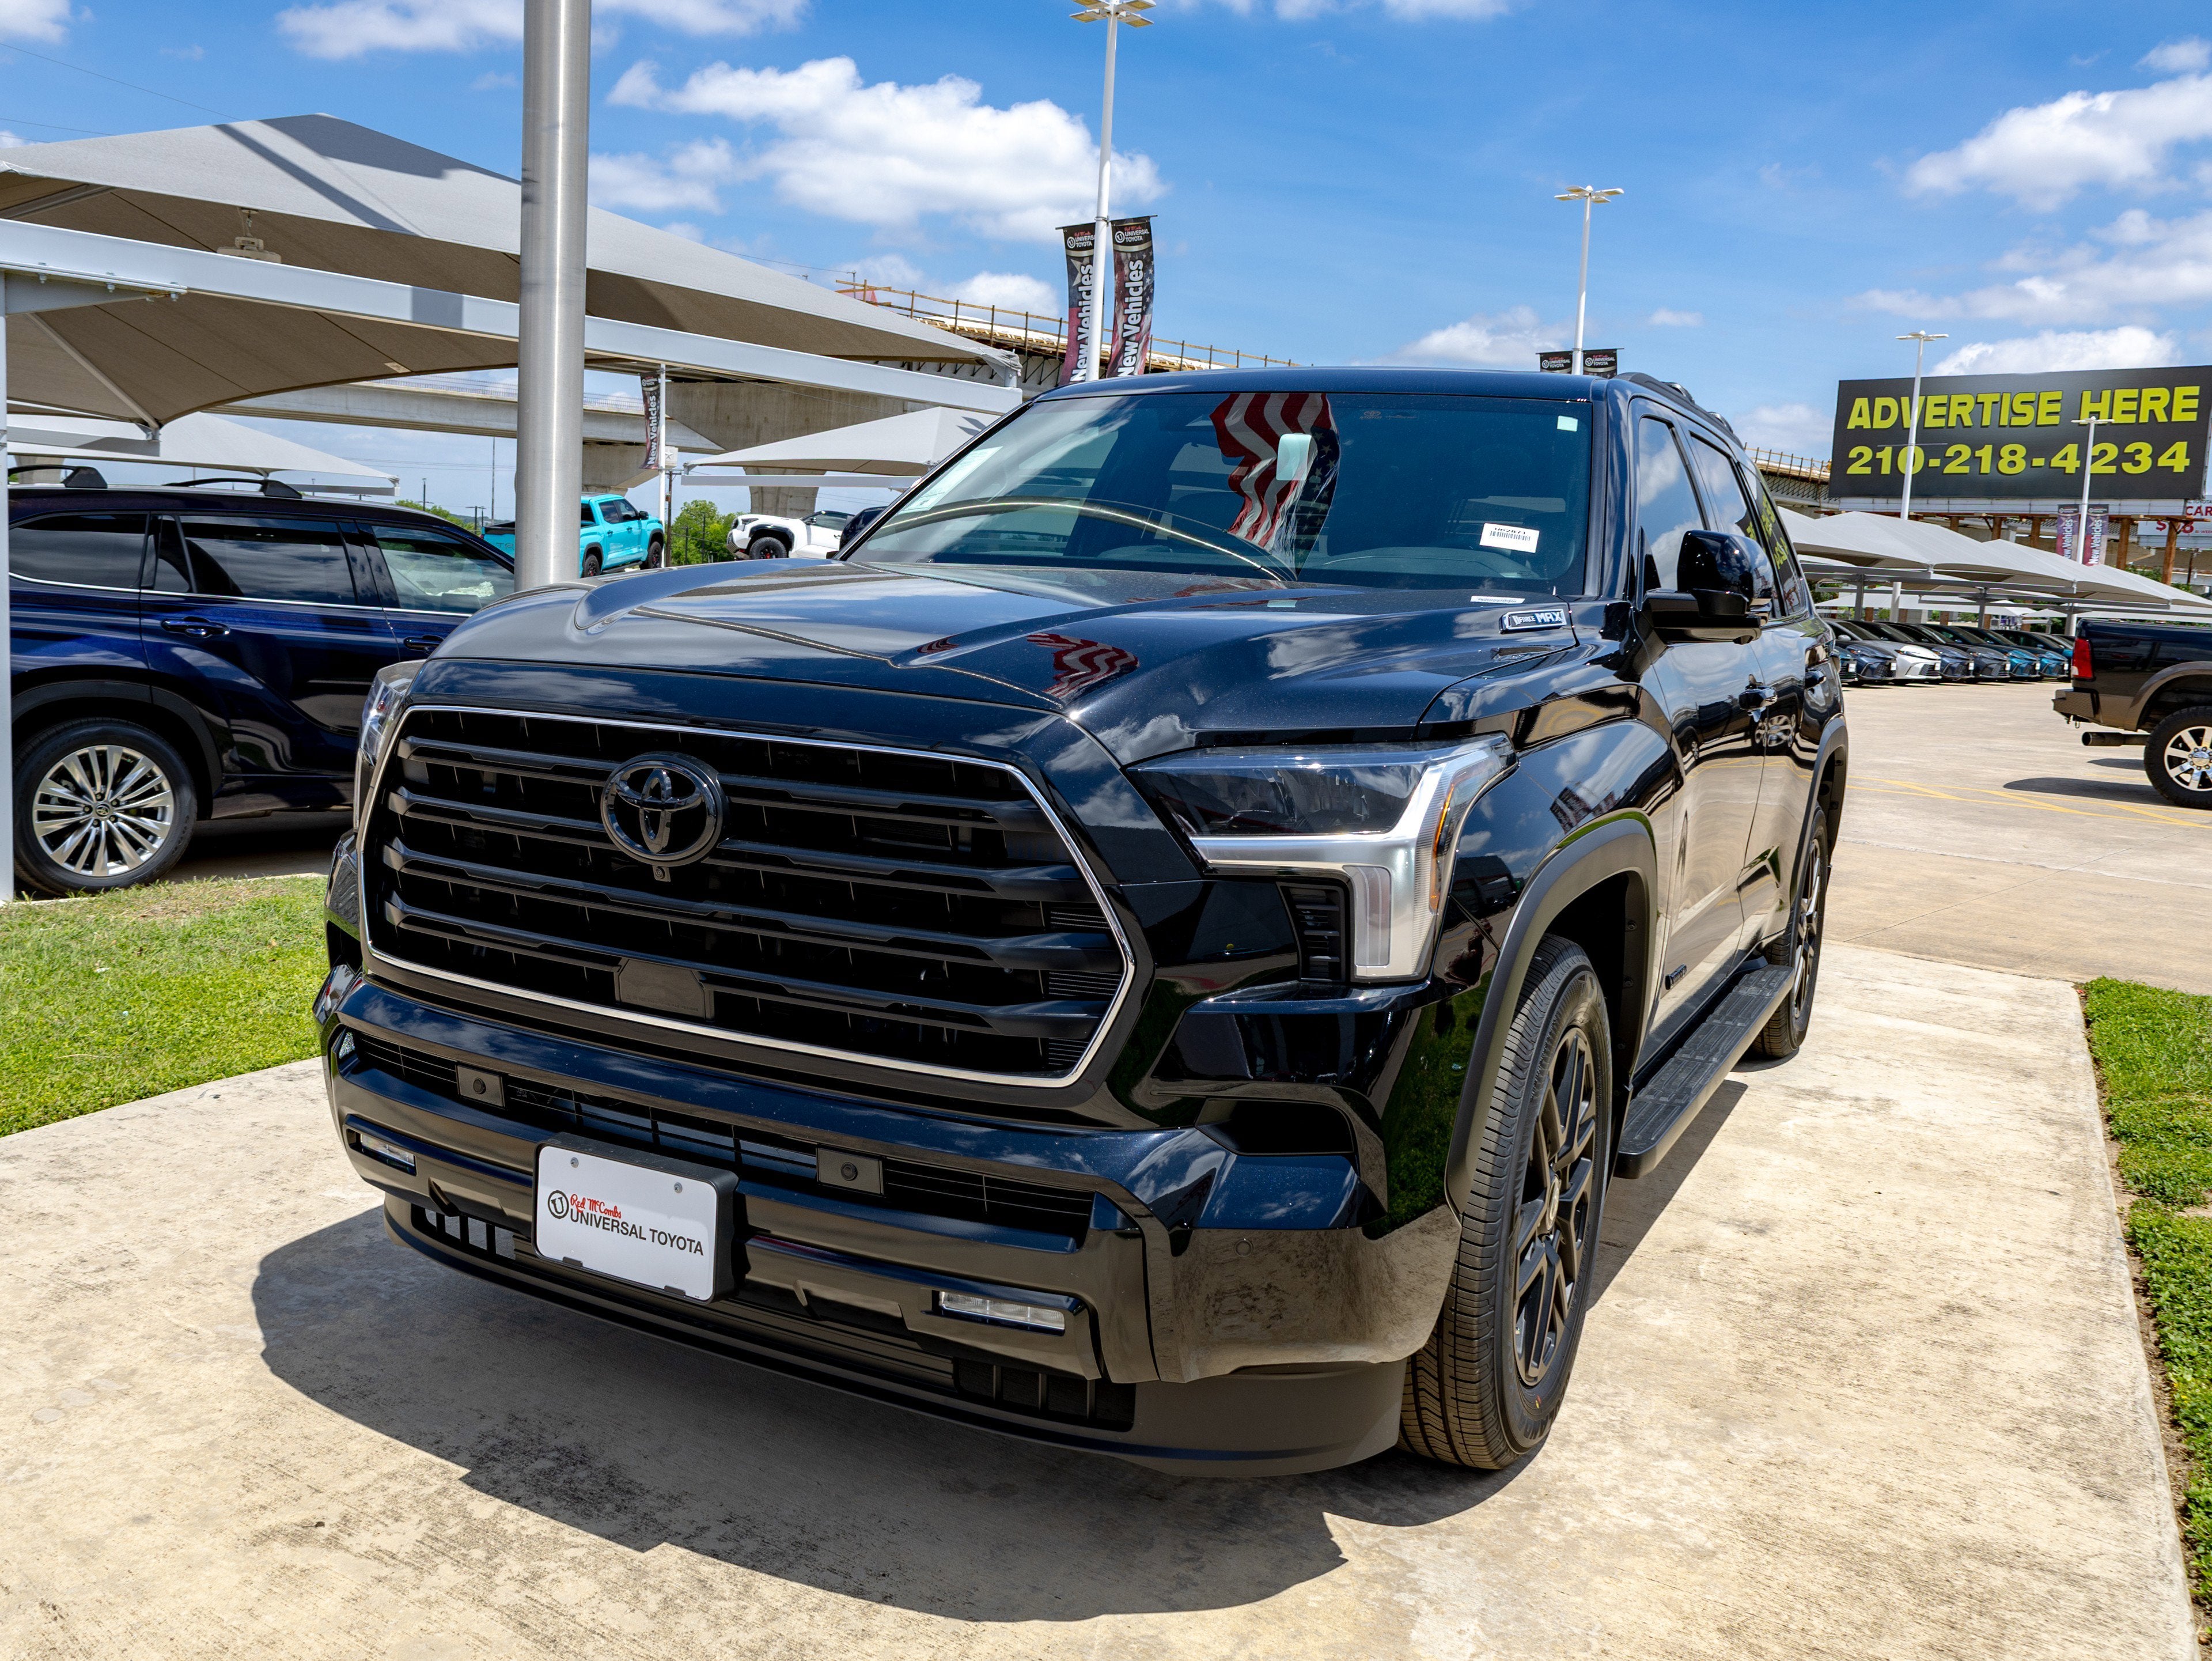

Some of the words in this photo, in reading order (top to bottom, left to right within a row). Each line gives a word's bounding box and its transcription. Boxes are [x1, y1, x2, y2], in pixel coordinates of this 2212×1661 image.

[1124, 229, 1149, 237] UNIVERSAL
[1077, 264, 1093, 341] Vehicles
[1122, 260, 1143, 338] Vehicles
[1070, 344, 1088, 381] New
[1118, 340, 1139, 377] New
[649, 395, 658, 440] Vehicles
[1847, 391, 2063, 429] ADVERTISE
[2080, 386, 2200, 425] HERE
[648, 441, 657, 465] New
[1846, 441, 2190, 475] 210-218-4234
[2062, 519, 2073, 548] Vehicles
[2090, 519, 2103, 548] Vehicles
[2063, 548, 2072, 559] ew
[2088, 549, 2100, 564] New
[1535, 612, 1563, 623] MAX
[570, 1194, 586, 1213] Red
[586, 1198, 622, 1219] McCombs
[570, 1208, 647, 1240] UNIVERSAL
[649, 1228, 704, 1256] TOYOTA
